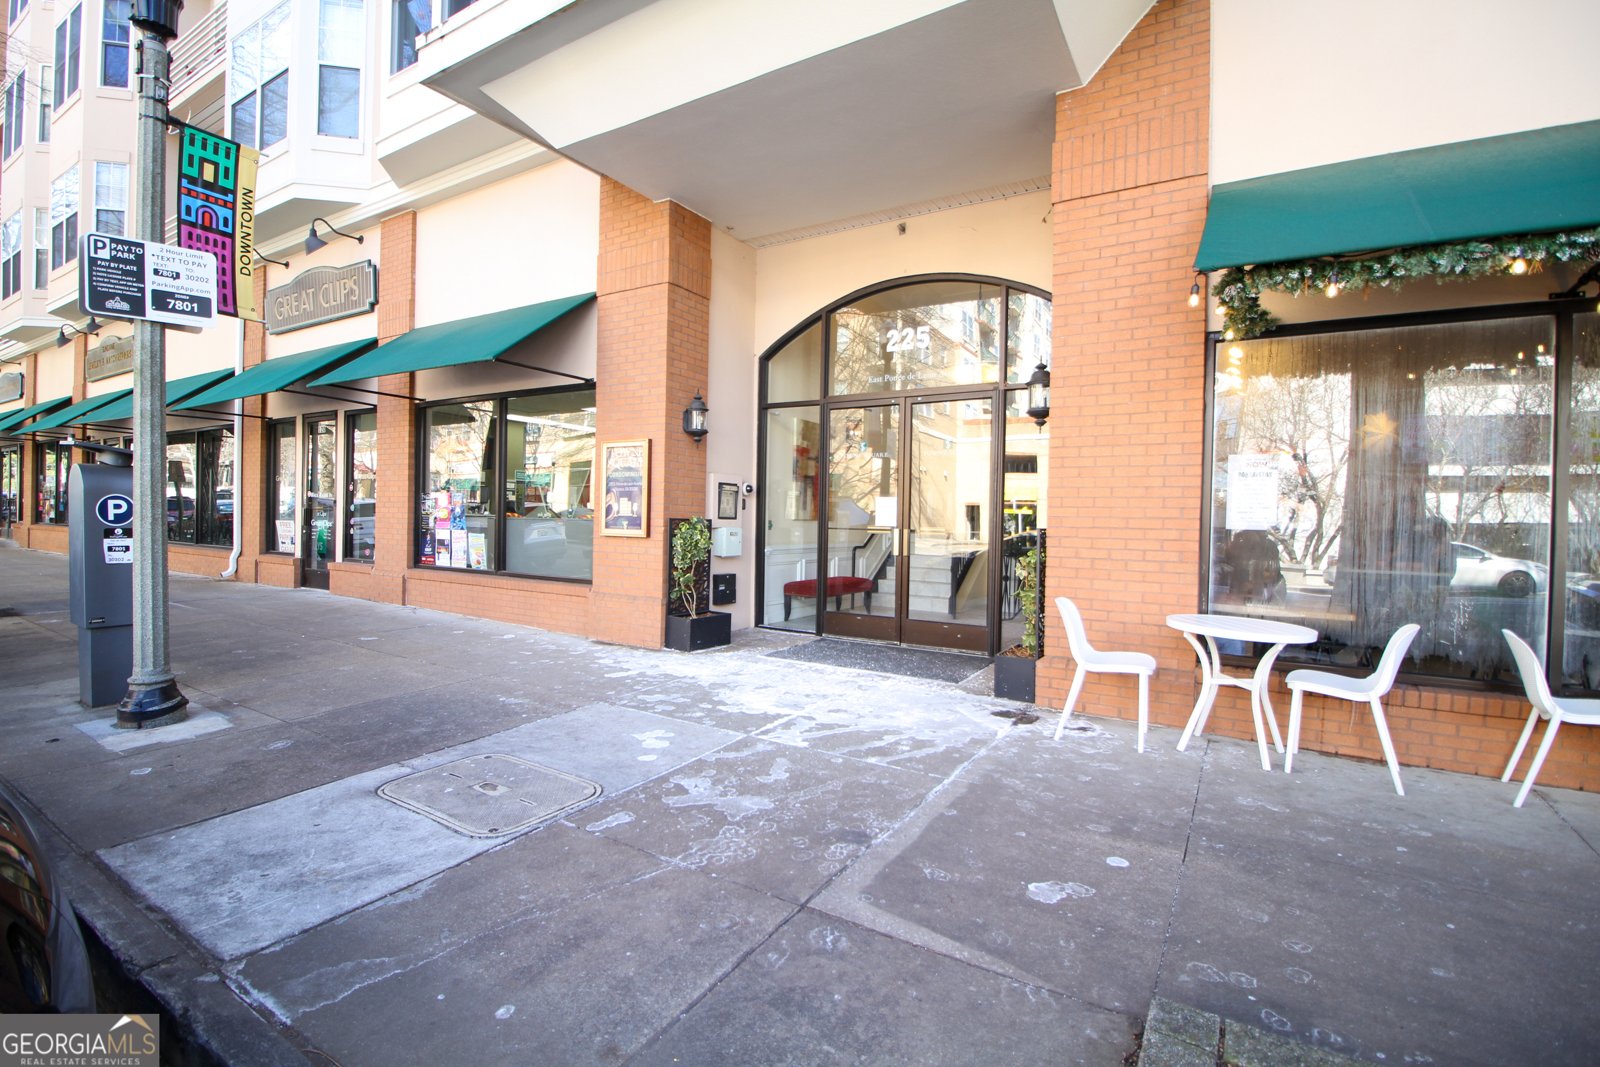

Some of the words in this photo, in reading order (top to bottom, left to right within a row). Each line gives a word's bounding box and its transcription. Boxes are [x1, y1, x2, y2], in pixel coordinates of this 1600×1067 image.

[239, 187, 253, 276] DOWNTOWN
[93, 238, 107, 255] P
[111, 243, 129, 251] PAY
[130, 246, 143, 255] TO
[111, 250, 136, 260] PARK
[165, 248, 183, 257] Hour
[185, 252, 203, 260] Limit
[119, 263, 137, 271] PLATE
[156, 254, 176, 263] TEXT
[178, 258, 190, 266] TO
[191, 261, 208, 269] PAY
[157, 269, 176, 278] 7801
[185, 274, 210, 283] 30202
[151, 281, 211, 295] ParkingApp.com
[275, 288, 315, 320] GREAT
[320, 274, 359, 308] CLIPS
[166, 298, 198, 312] 7801
[886, 325, 930, 352] 225
[868, 375, 882, 384] East
[884, 373, 905, 382] Ponce
[907, 371, 916, 380] de
[107, 499, 128, 520] P
